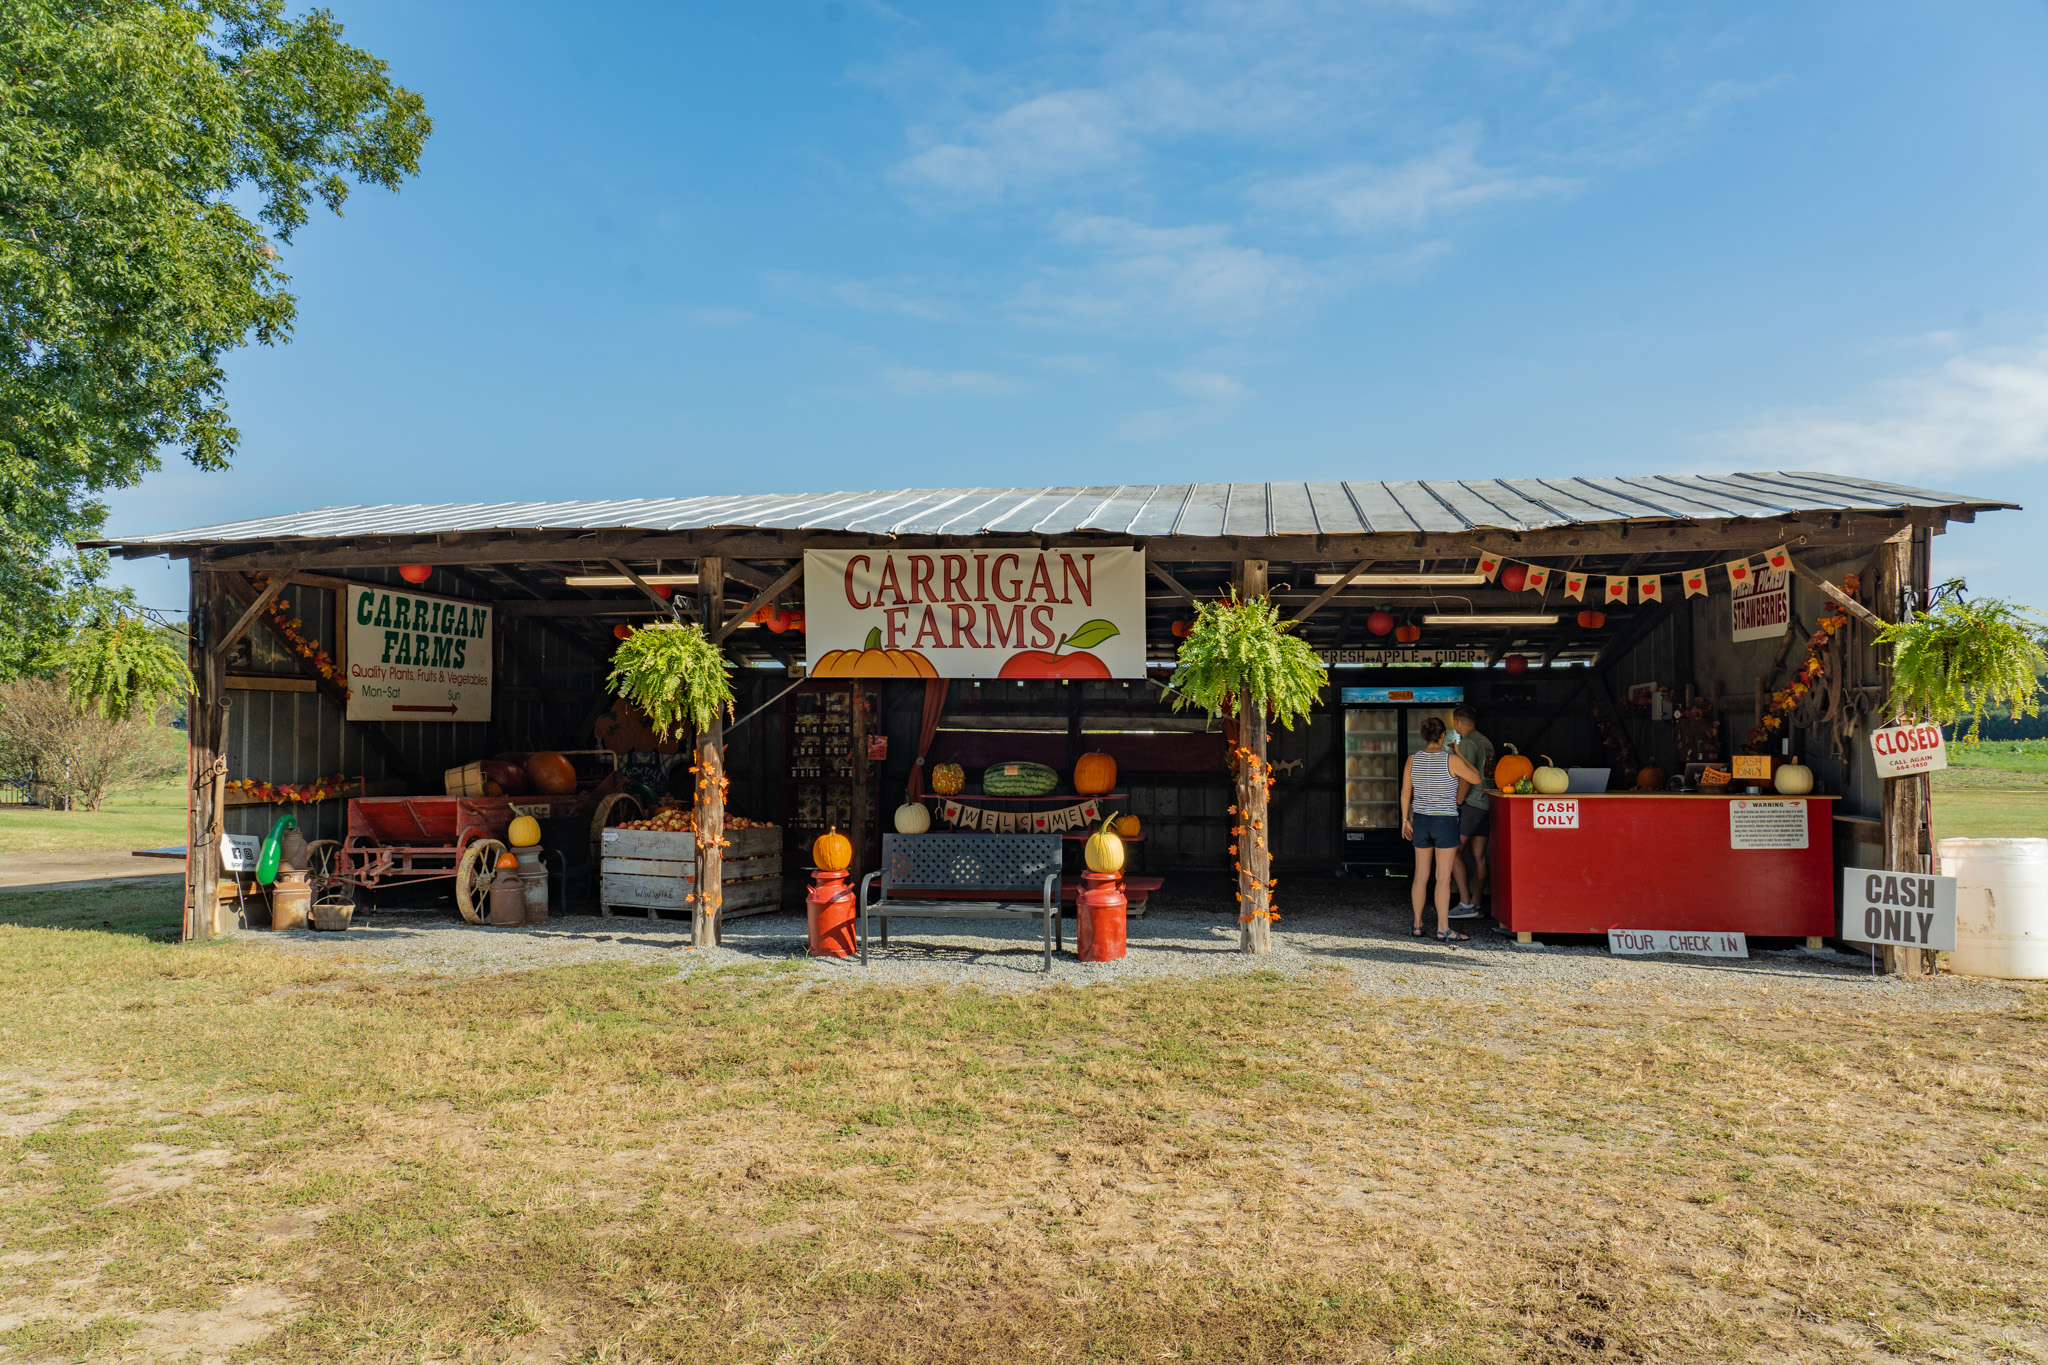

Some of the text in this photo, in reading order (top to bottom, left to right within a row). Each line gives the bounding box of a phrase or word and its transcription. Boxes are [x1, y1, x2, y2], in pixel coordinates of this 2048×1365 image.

[844, 553, 1095, 610] CARRIGAN
[1757, 569, 1786, 592] PICKED
[356, 591, 487, 639] CARRIGAN
[1733, 592, 1787, 631] STRAWBERRIES
[883, 603, 1057, 650] FARMS
[381, 630, 467, 669] FARMS
[1321, 650, 1475, 663] FRESH APPLE CIDER
[351, 663, 488, 687] Quality Plants, Fruits & Vegetables
[361, 684, 461, 700] Mon-Sat Sun
[1875, 726, 1939, 756] CLOSED
[1735, 756, 1762, 767] CASH
[1909, 755, 1933, 763] AGAIN
[1737, 767, 1763, 777] ONLY
[1537, 803, 1575, 812] CASH
[1537, 815, 1575, 825] ONLY
[1865, 874, 1935, 909] CASH
[1864, 907, 1935, 944] ONLY
[1612, 933, 1738, 953] TOUR CHECK IN
